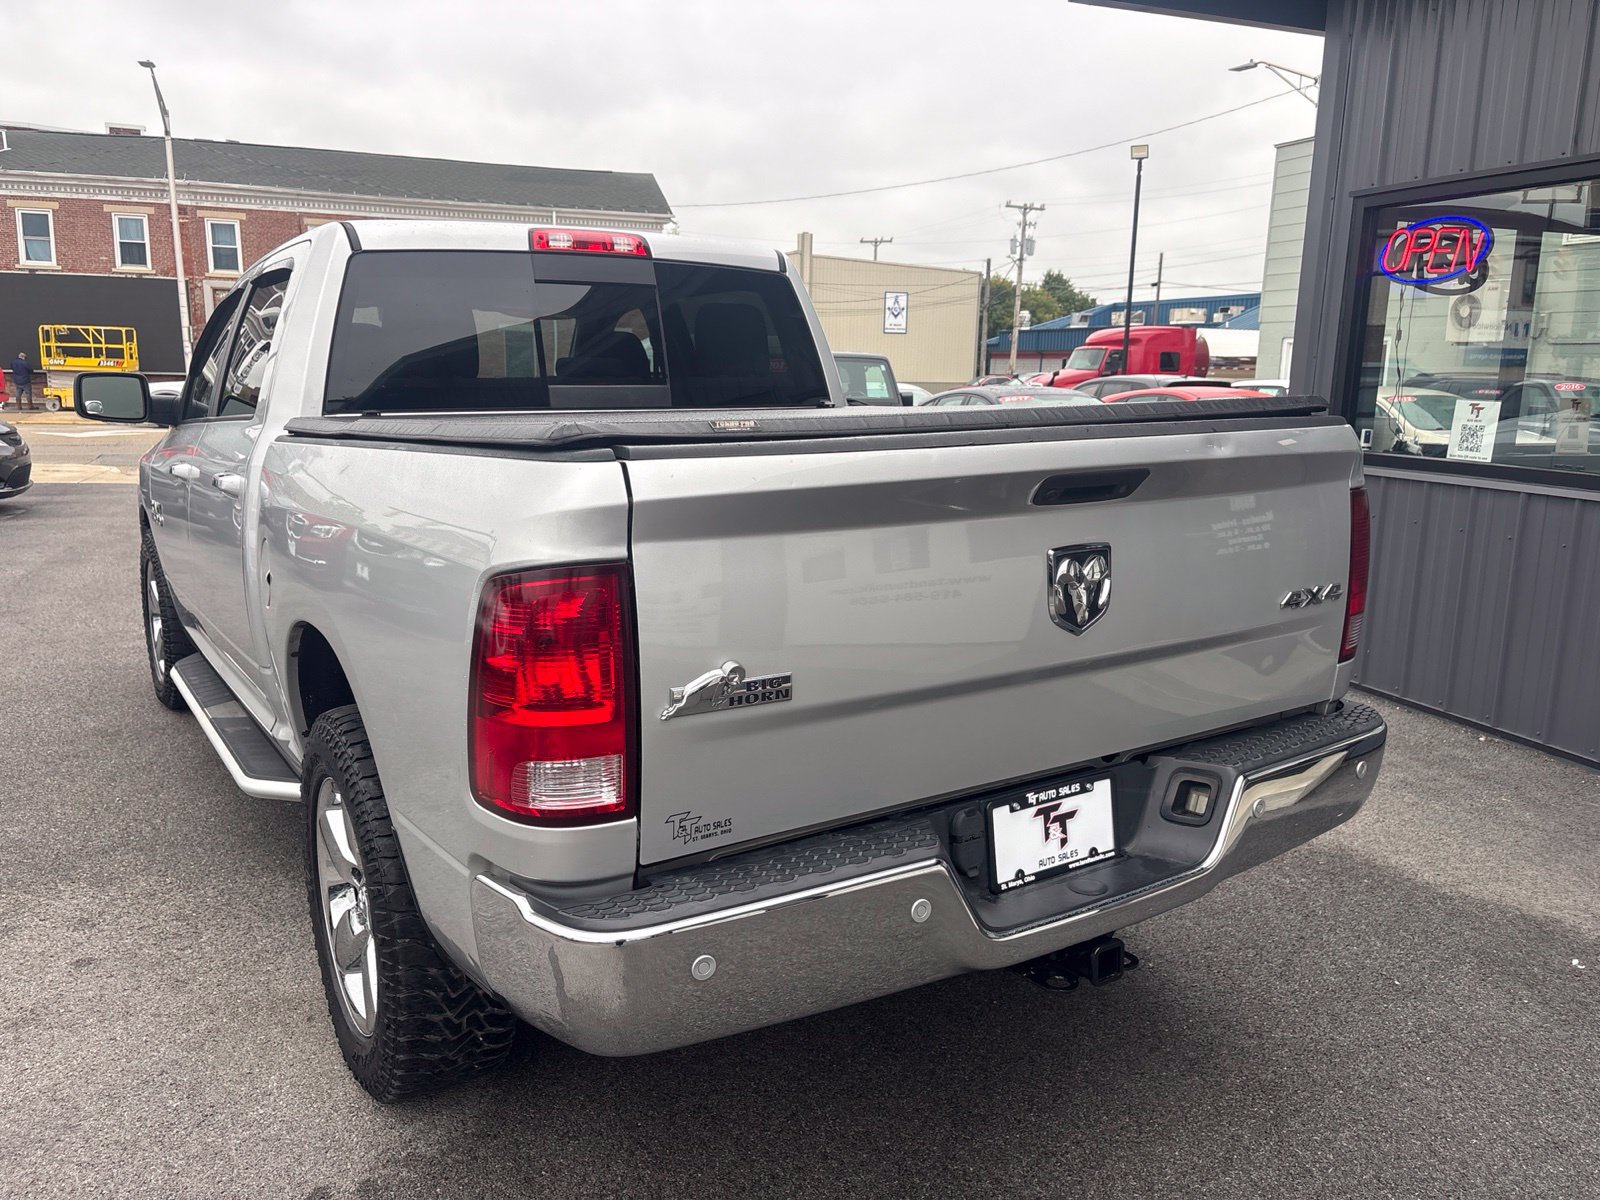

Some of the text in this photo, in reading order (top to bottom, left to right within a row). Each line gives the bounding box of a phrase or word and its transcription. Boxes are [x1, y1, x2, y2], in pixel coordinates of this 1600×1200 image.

[1382, 227, 1485, 273] OPEN
[746, 676, 783, 692] BIG
[728, 688, 790, 707] HORN
[1039, 789, 1057, 802] AUTO
[1058, 783, 1080, 797] SALES
[694, 818, 732, 835] AUTO SALES
[1038, 849, 1079, 868] AUTO SALES
